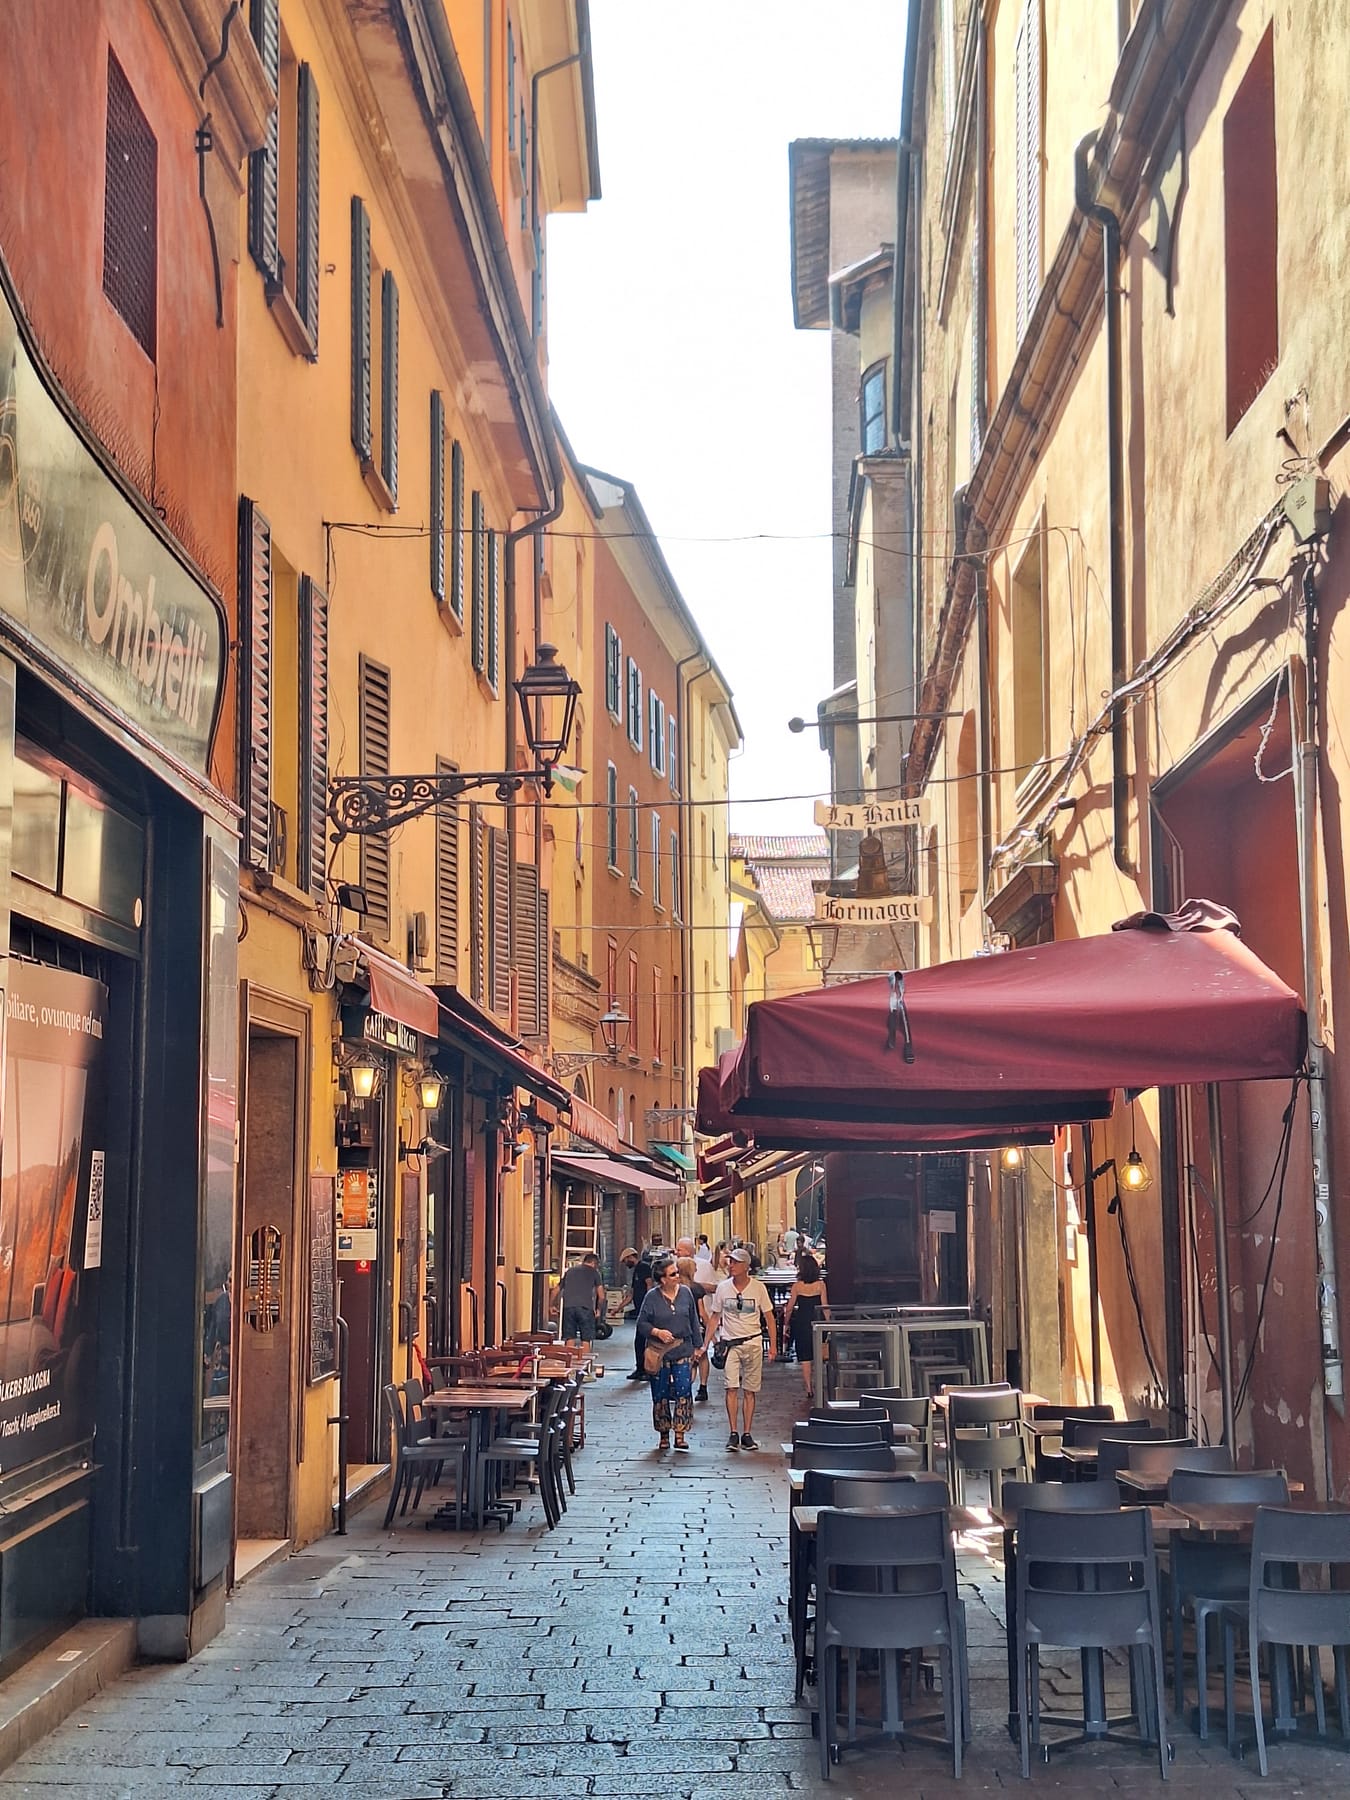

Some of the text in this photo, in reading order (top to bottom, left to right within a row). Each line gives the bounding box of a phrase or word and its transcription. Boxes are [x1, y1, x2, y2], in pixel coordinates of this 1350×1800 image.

[86, 522, 208, 728] Ombrelli
[826, 802, 921, 827] La Baita
[820, 897, 920, 921] Formaggi
[41, 1007, 81, 1036] ovunque
[22, 1369, 51, 1395] BOLOGNA
